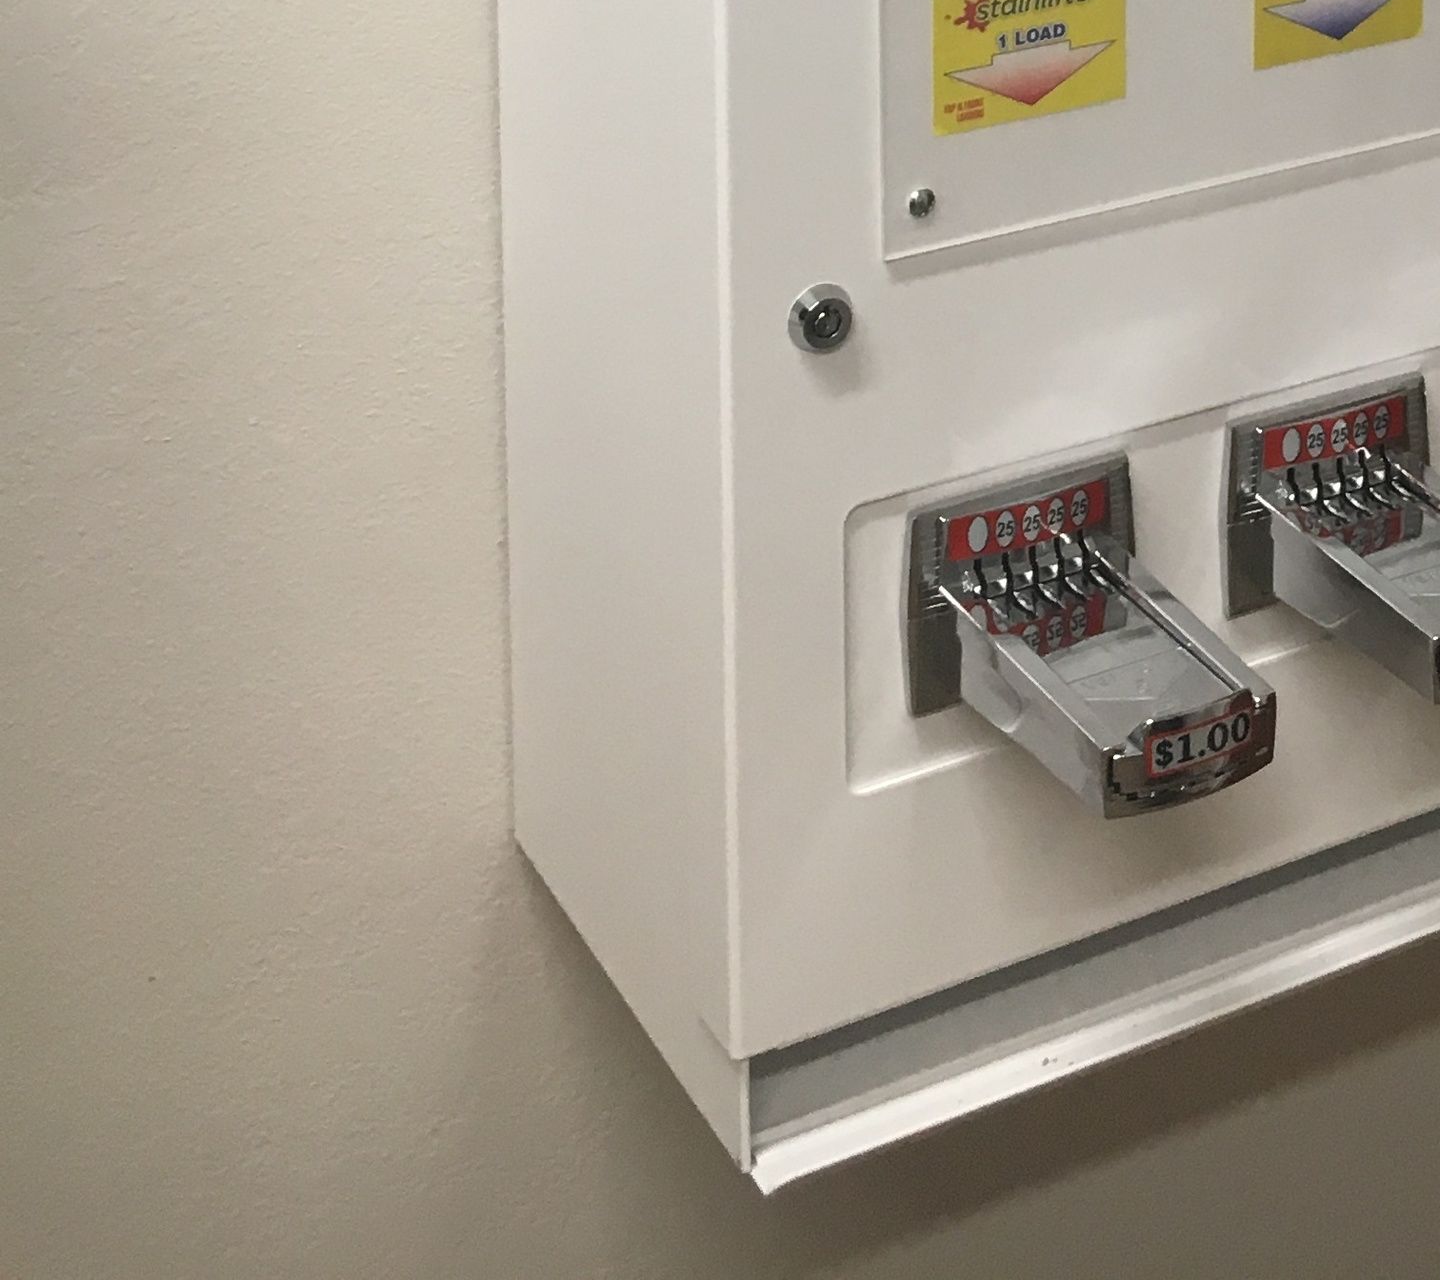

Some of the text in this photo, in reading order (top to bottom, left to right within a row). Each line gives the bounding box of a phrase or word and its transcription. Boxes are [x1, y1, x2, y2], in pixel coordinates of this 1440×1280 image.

[998, 23, 1067, 49] 1 LOAD
[1308, 412, 1389, 449] 25 25 25 25
[997, 495, 1089, 538] 25 25 25 25
[1154, 711, 1250, 770] $1.00
